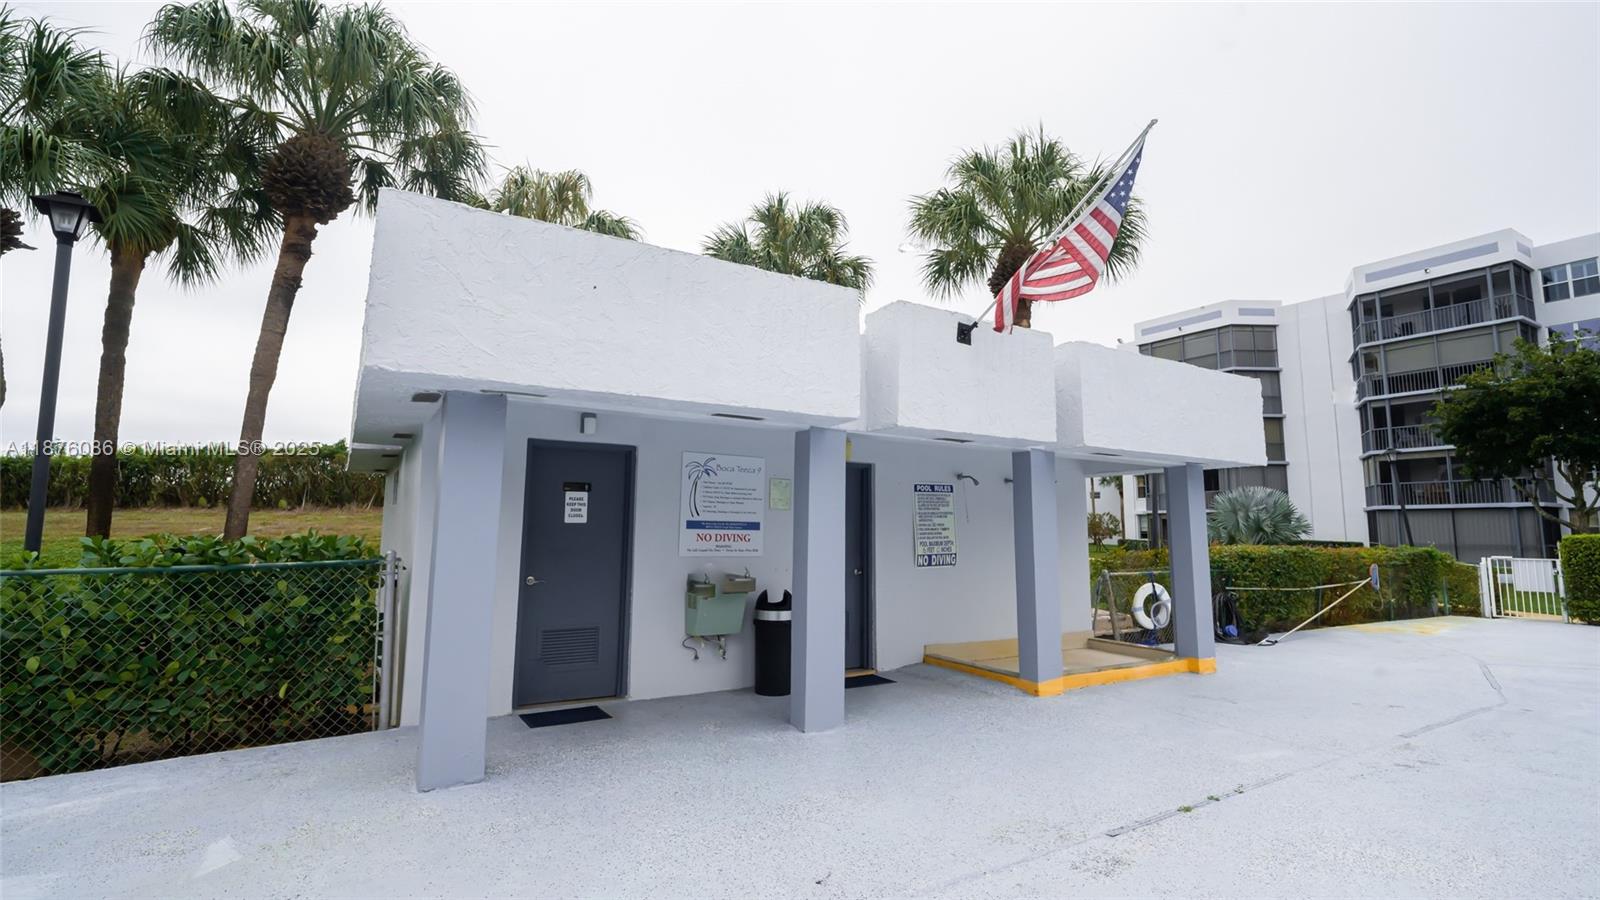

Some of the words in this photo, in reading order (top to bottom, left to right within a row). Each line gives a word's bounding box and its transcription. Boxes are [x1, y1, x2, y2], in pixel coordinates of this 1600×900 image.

[696, 533, 713, 542] NO
[715, 533, 751, 543] DIVING
[917, 555, 929, 566] NO
[931, 554, 956, 566] DIVING
